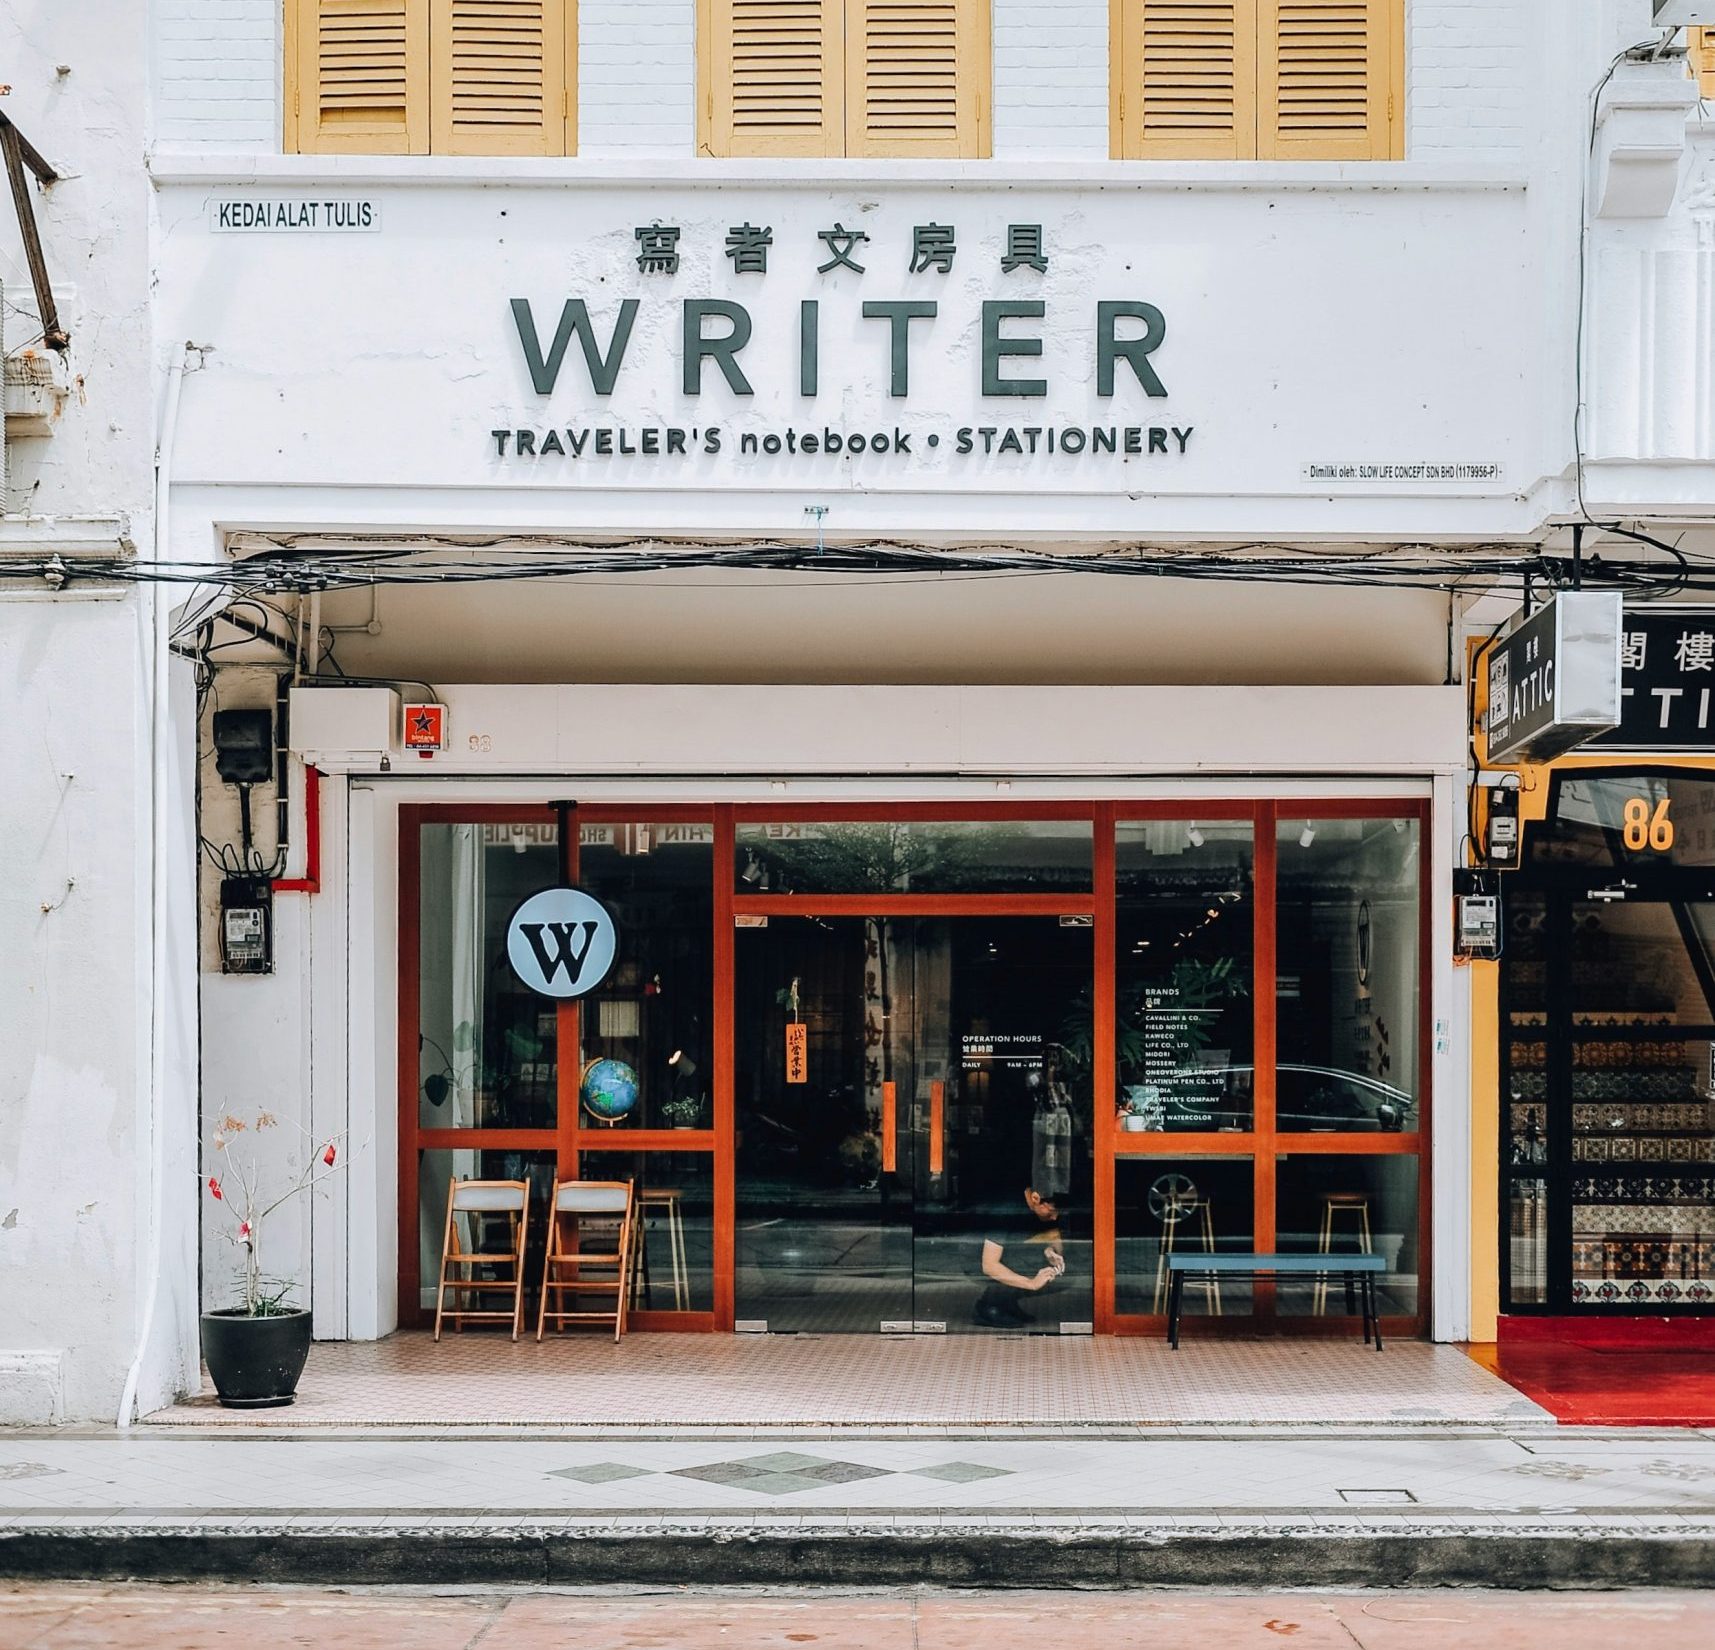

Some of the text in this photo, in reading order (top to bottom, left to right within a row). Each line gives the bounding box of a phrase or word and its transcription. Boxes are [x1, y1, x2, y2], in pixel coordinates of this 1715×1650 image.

[220, 202, 372, 227] KEDAI ALAT TULIS
[634, 222, 1049, 275] 寫者文房具
[510, 299, 1169, 397] WRITER
[491, 426, 1194, 457] TRAVELER'S notebook STATIONERY
[1310, 465, 1338, 479] Dimiliki
[1339, 465, 1358, 479] oleh:
[1359, 465, 1379, 479] SLOW
[1379, 465, 1393, 479] LIFE
[1394, 465, 1426, 479] CONCEPT
[1426, 465, 1440, 479] SDN
[1440, 465, 1455, 479] BHD
[1511, 659, 1553, 725] ATTIC
[1622, 798, 1675, 852] 86
[518, 920, 600, 986] W
[1145, 988, 1180, 996] BRANDS
[962, 1035, 1042, 1043] OPERATION HOURS
